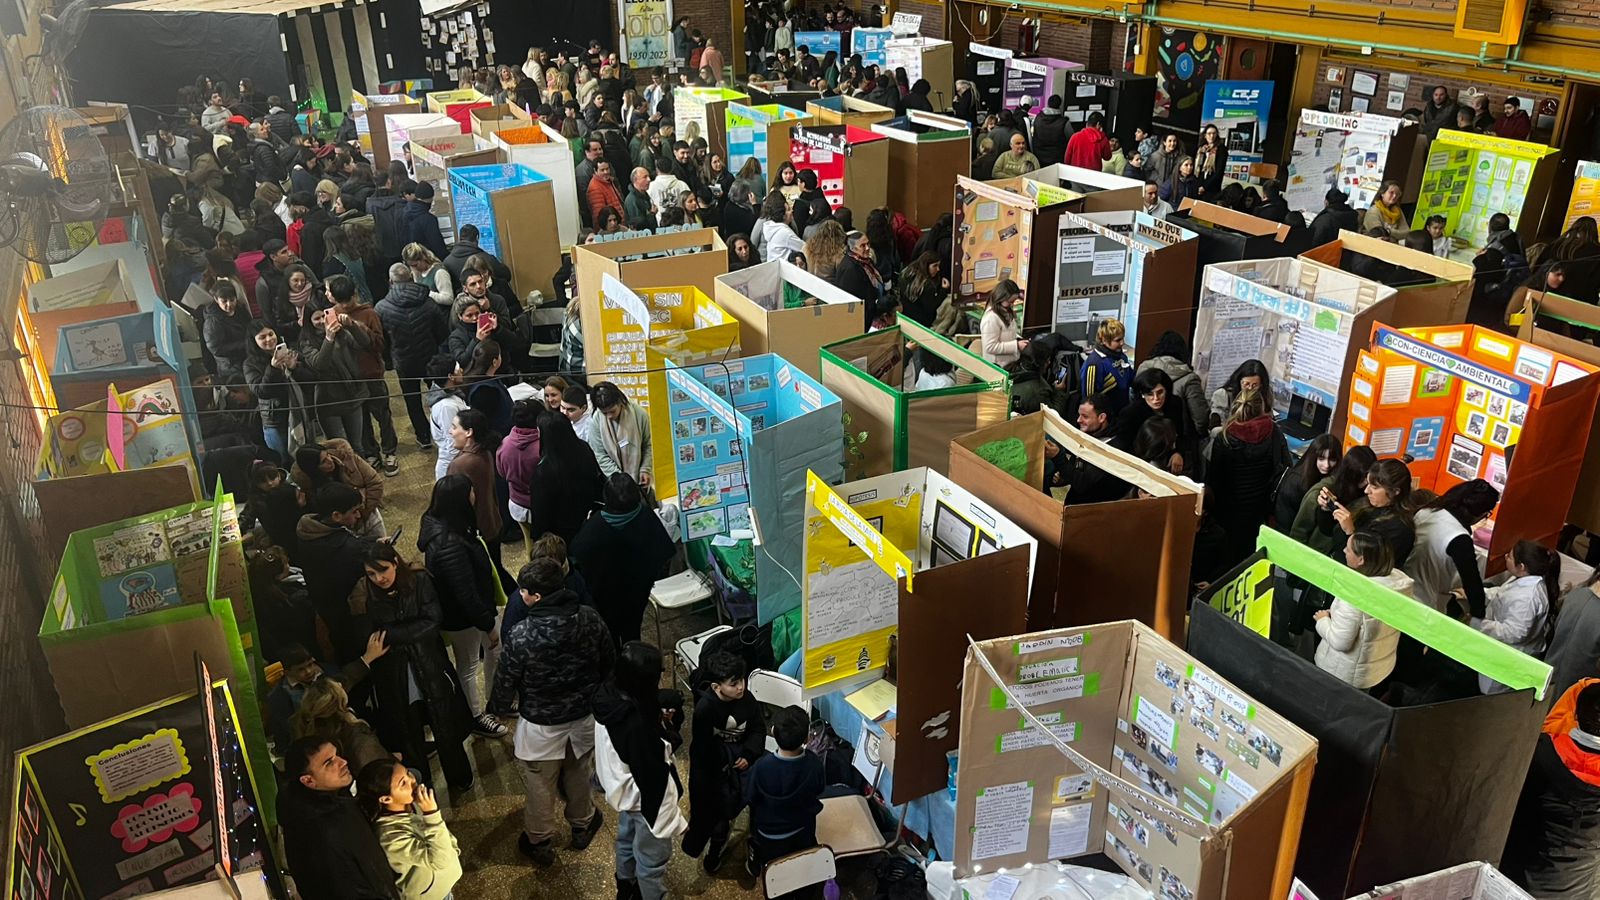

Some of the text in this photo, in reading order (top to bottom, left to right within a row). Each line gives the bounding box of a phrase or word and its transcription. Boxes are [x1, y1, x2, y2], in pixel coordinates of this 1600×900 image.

[629, 50, 668, 60] 1950 2025
[1068, 214, 1149, 253] NADIE SE SALVA SOLO
[1154, 218, 1180, 236] LO QUE
[1061, 284, 1119, 297] HIPÓTESIS
[654, 293, 682, 307] SIN
[1391, 337, 1509, 391] CON-CIENCIA AMBIENTAL
[1024, 690, 1048, 698] HUERTA
[98, 742, 152, 766] Conclusiones
